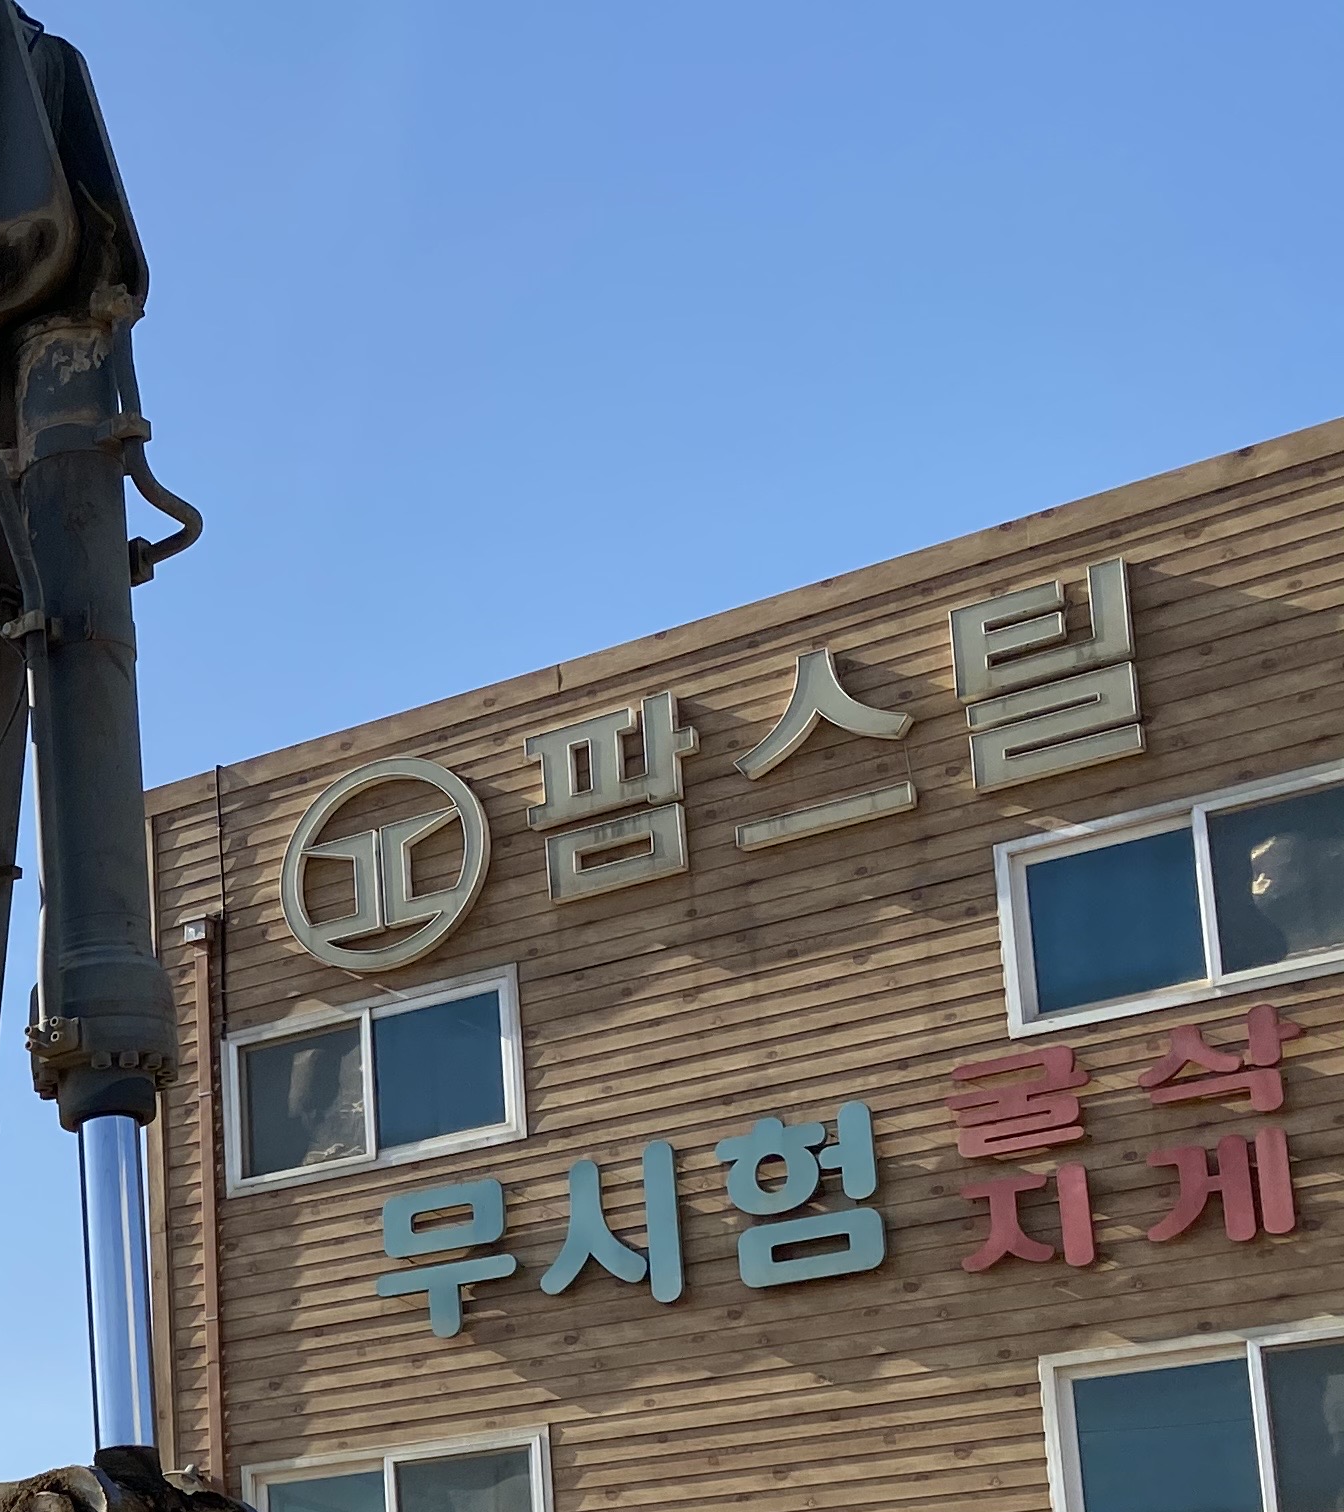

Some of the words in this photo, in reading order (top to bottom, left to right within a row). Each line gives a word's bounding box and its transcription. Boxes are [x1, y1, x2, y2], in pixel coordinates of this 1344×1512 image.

[525, 556, 1147, 904] 팜스틸
[944, 1003, 1304, 1159] 굴삭
[375, 1100, 889, 1339] 무시험
[959, 1124, 1298, 1274] 지게
